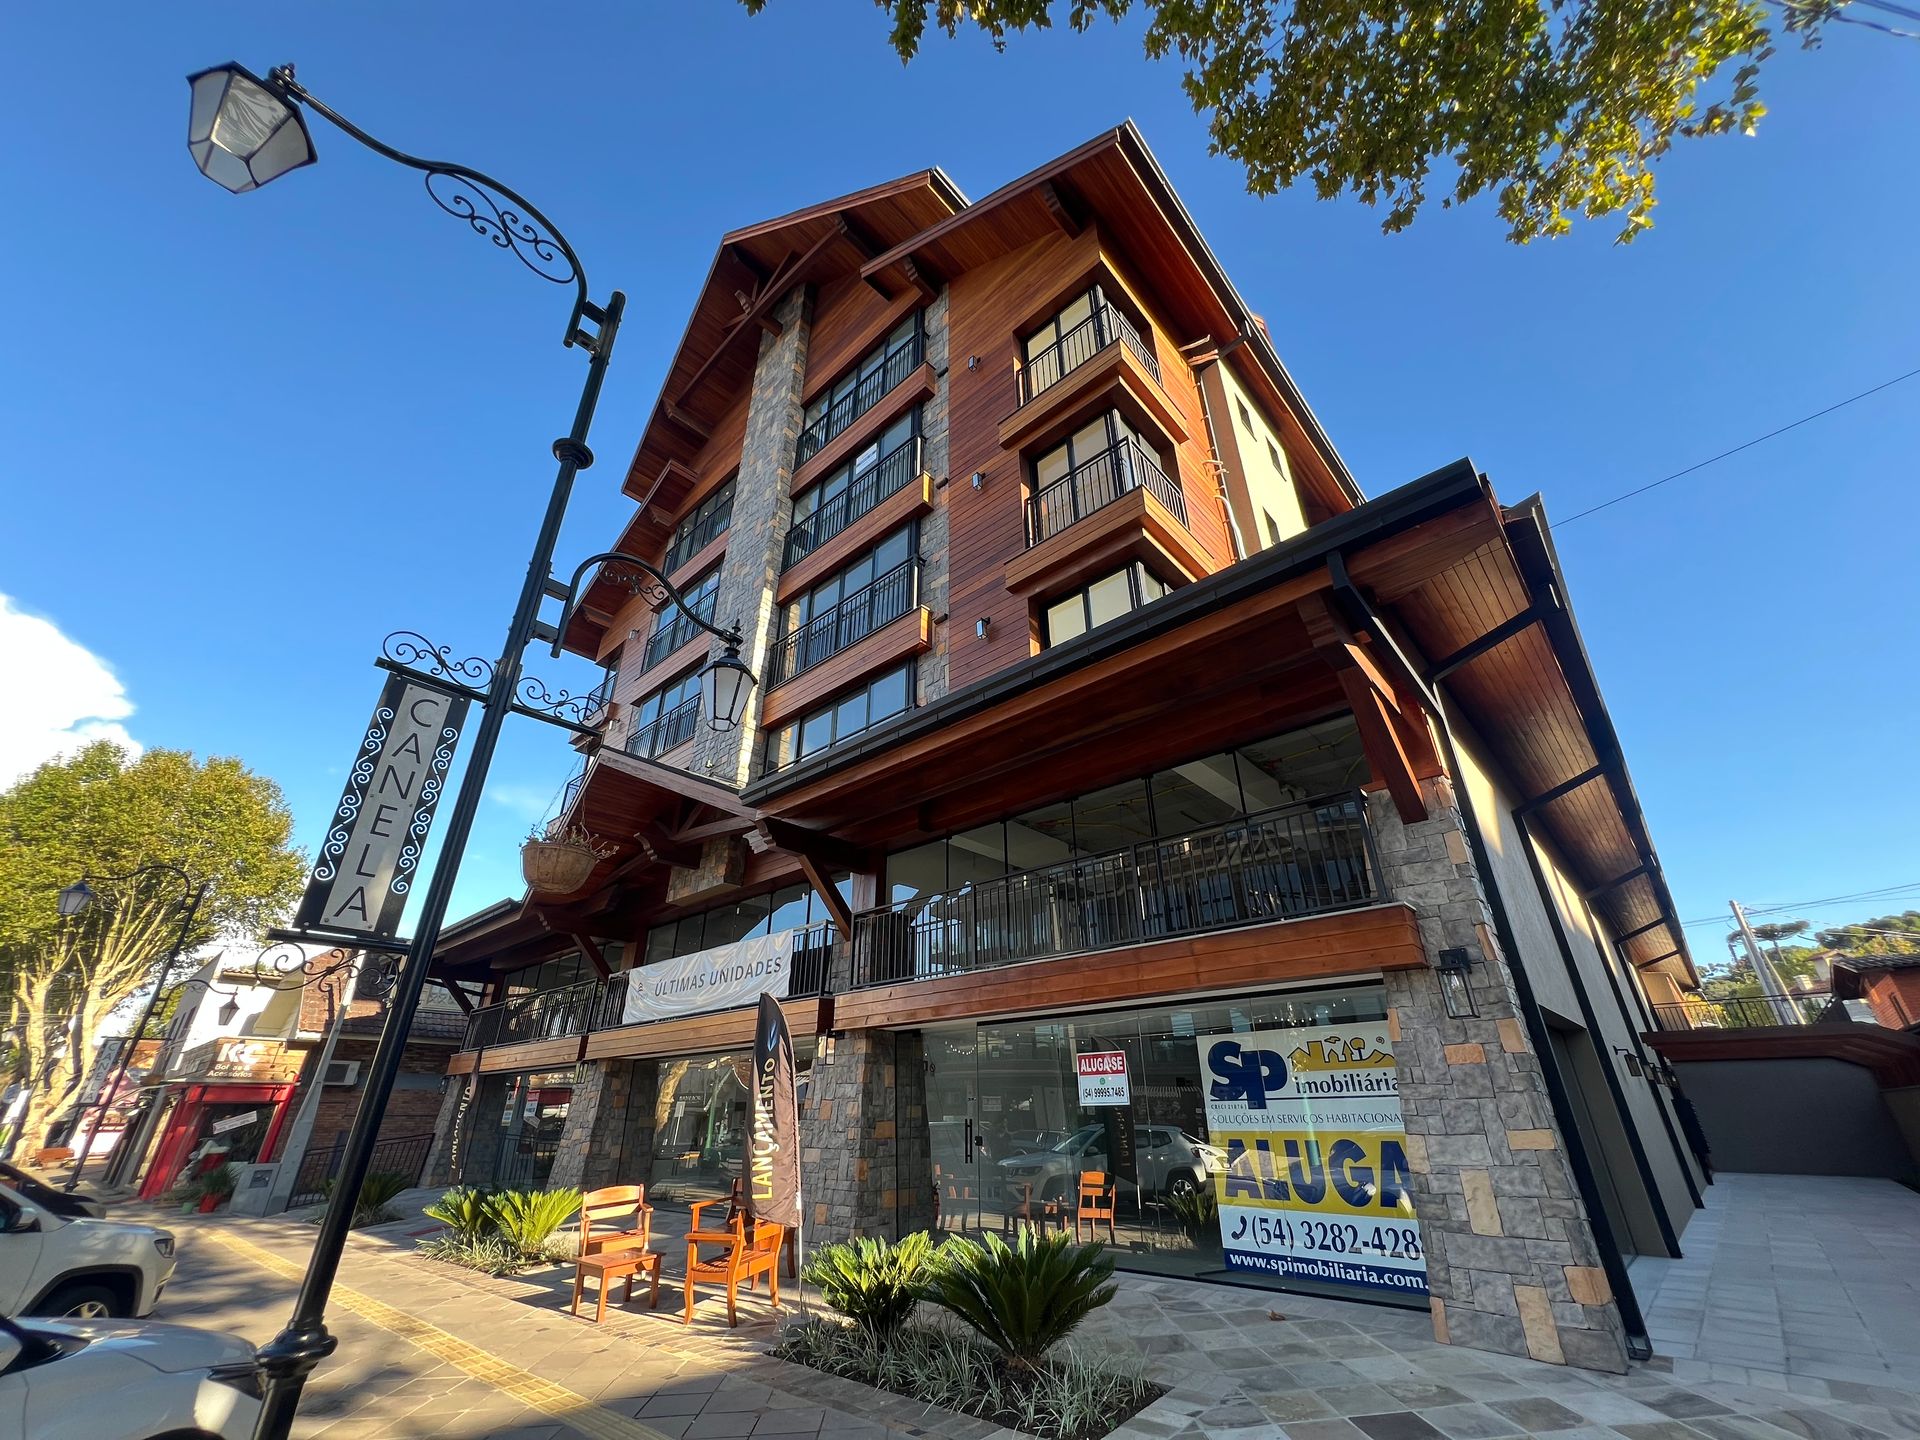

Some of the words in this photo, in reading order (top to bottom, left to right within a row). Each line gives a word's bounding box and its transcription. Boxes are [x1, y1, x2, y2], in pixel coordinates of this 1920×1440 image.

[333, 699, 440, 922] CANELA
[654, 973, 705, 997] ÚLTIMAS
[710, 956, 782, 986] UNIDADES
[82, 1042, 119, 1101] CANELA
[214, 1063, 242, 1071] Bolas
[1295, 1072, 1400, 1094] imobiliária
[752, 1057, 780, 1200] LANÇAMENTO
[1212, 1112, 1259, 1126] SOLUÇÕES
[1262, 1114, 1276, 1124] EM
[1277, 1113, 1324, 1126] SERVIÇOS
[1225, 1138, 1416, 1209] ALUGA
[1251, 1215, 1295, 1251] (54)
[1299, 1220, 1425, 1261] 3282-428
